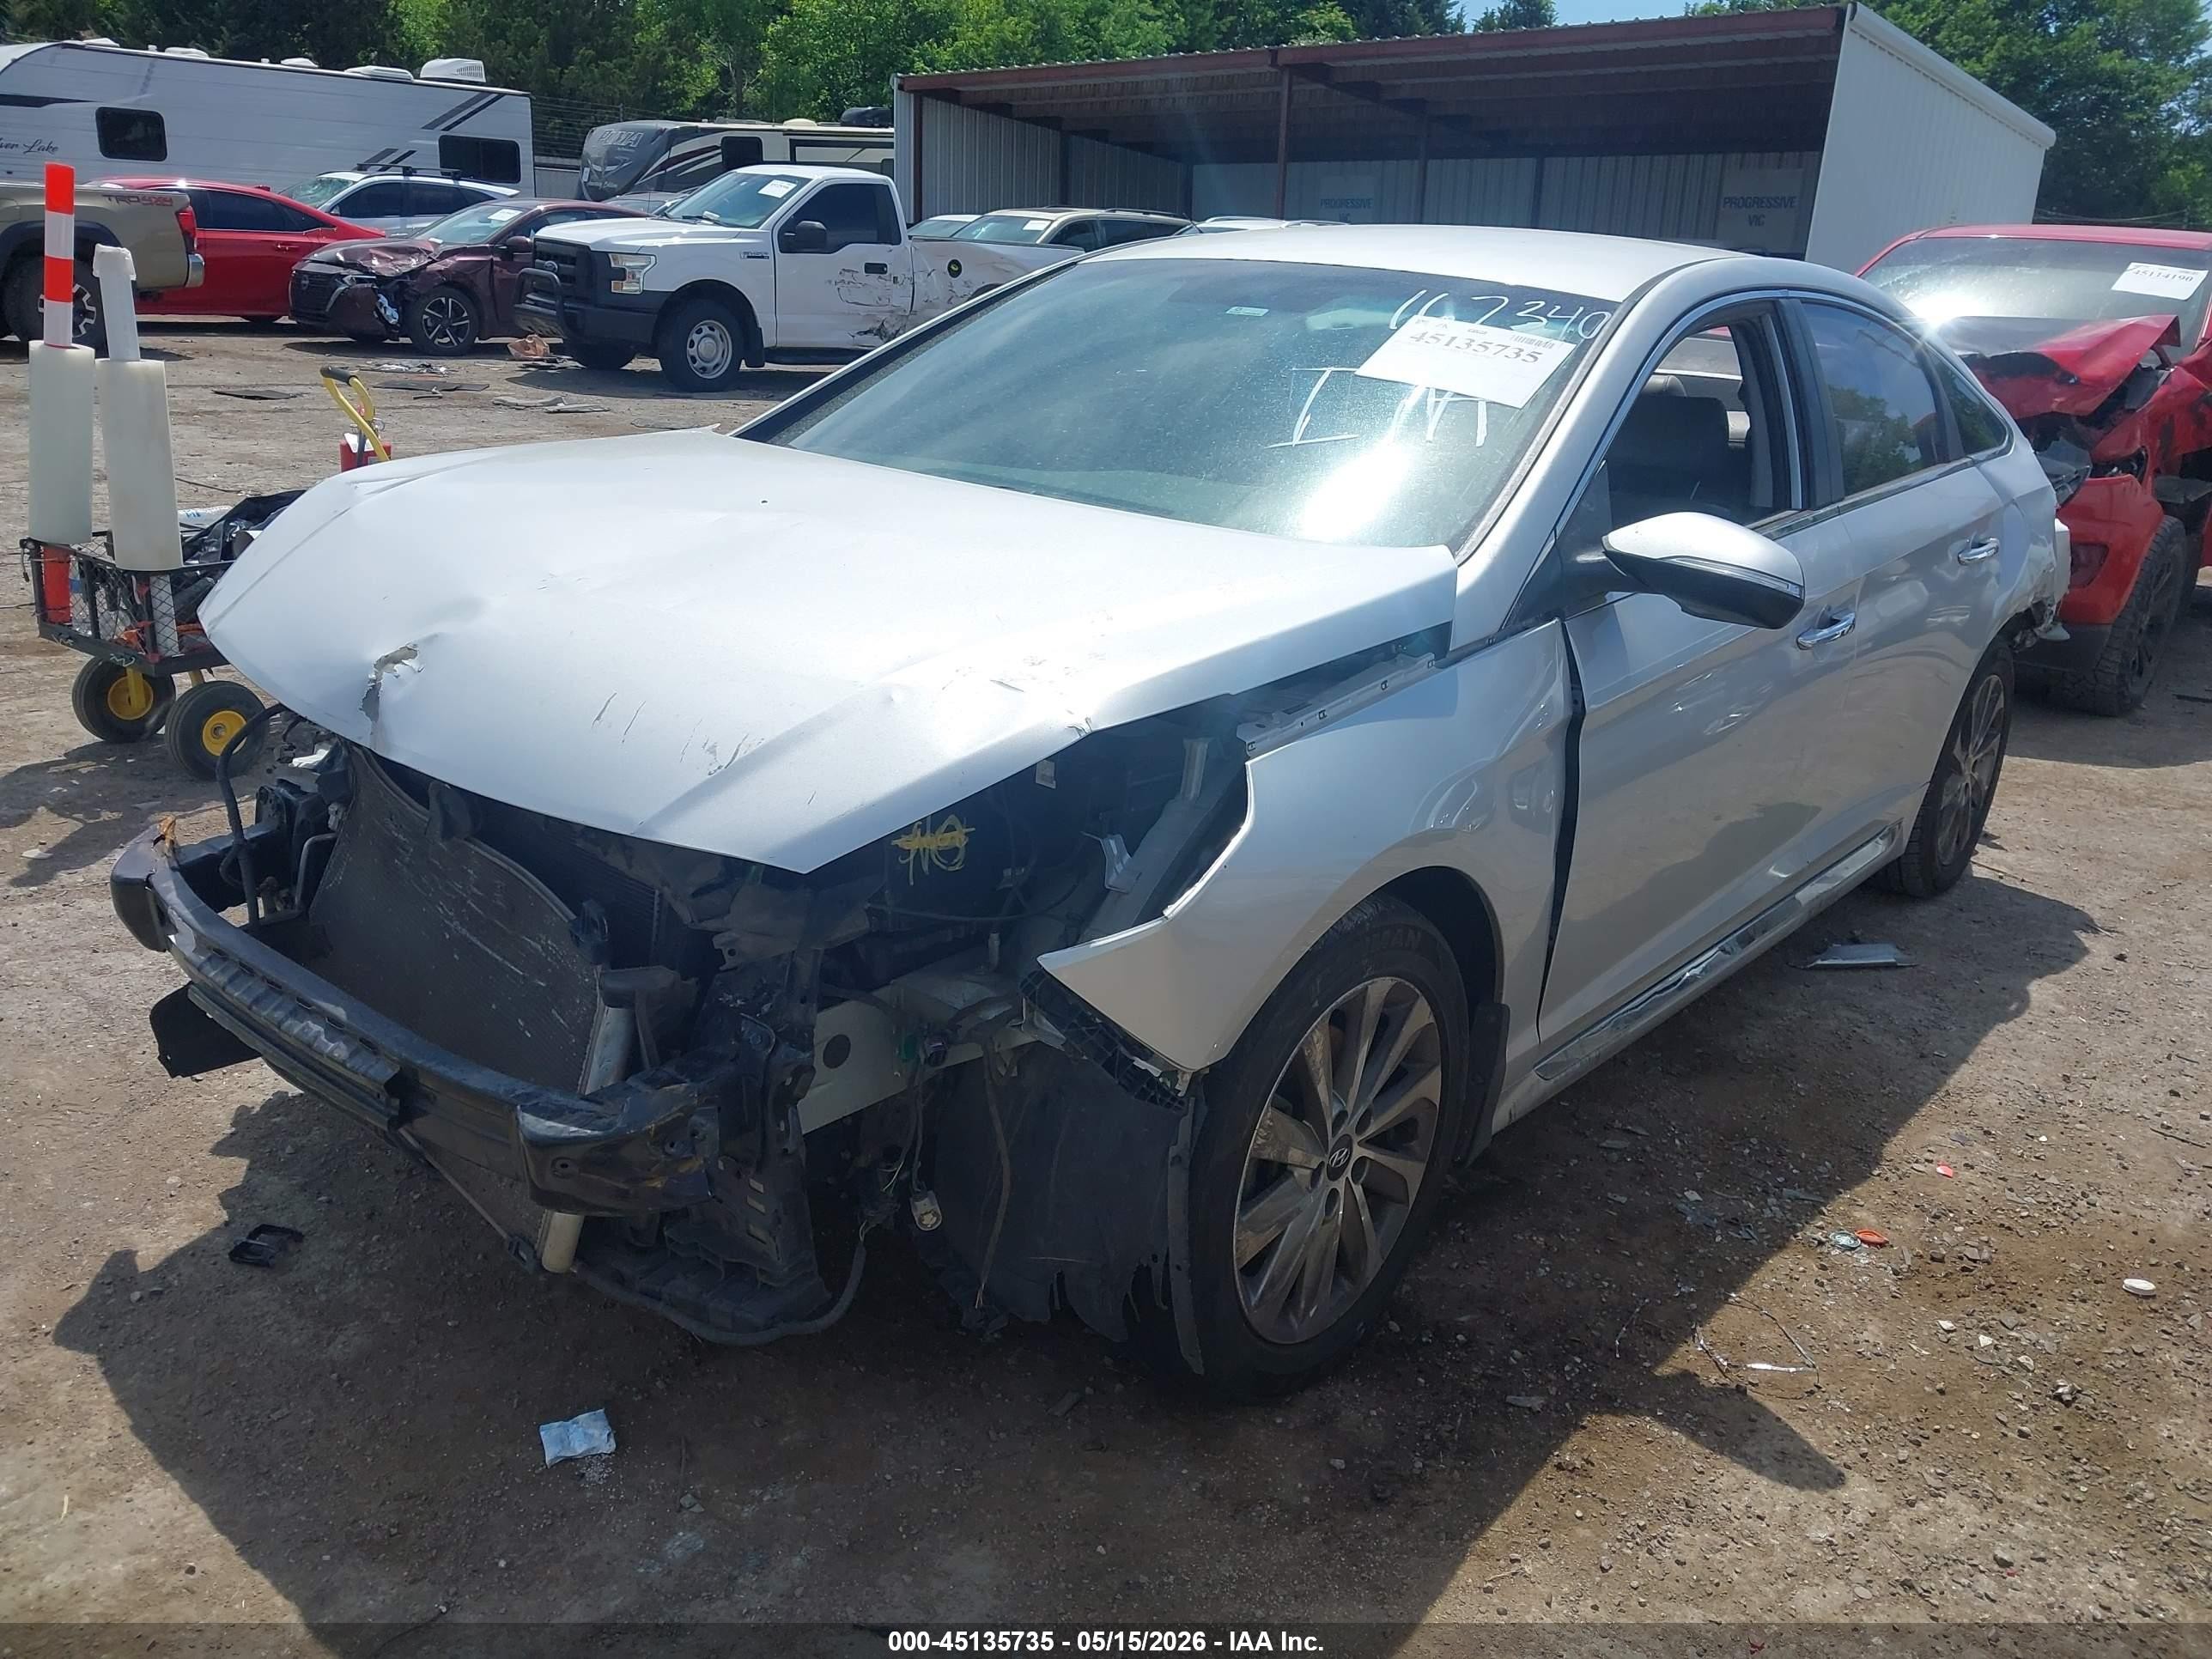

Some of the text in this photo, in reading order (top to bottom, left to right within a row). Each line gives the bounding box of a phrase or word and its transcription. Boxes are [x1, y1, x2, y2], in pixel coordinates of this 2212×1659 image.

[22, 138, 59, 155] Lake
[1723, 196, 1797, 209] PROGRESSIVE
[1408, 331, 1543, 364] 45135735
